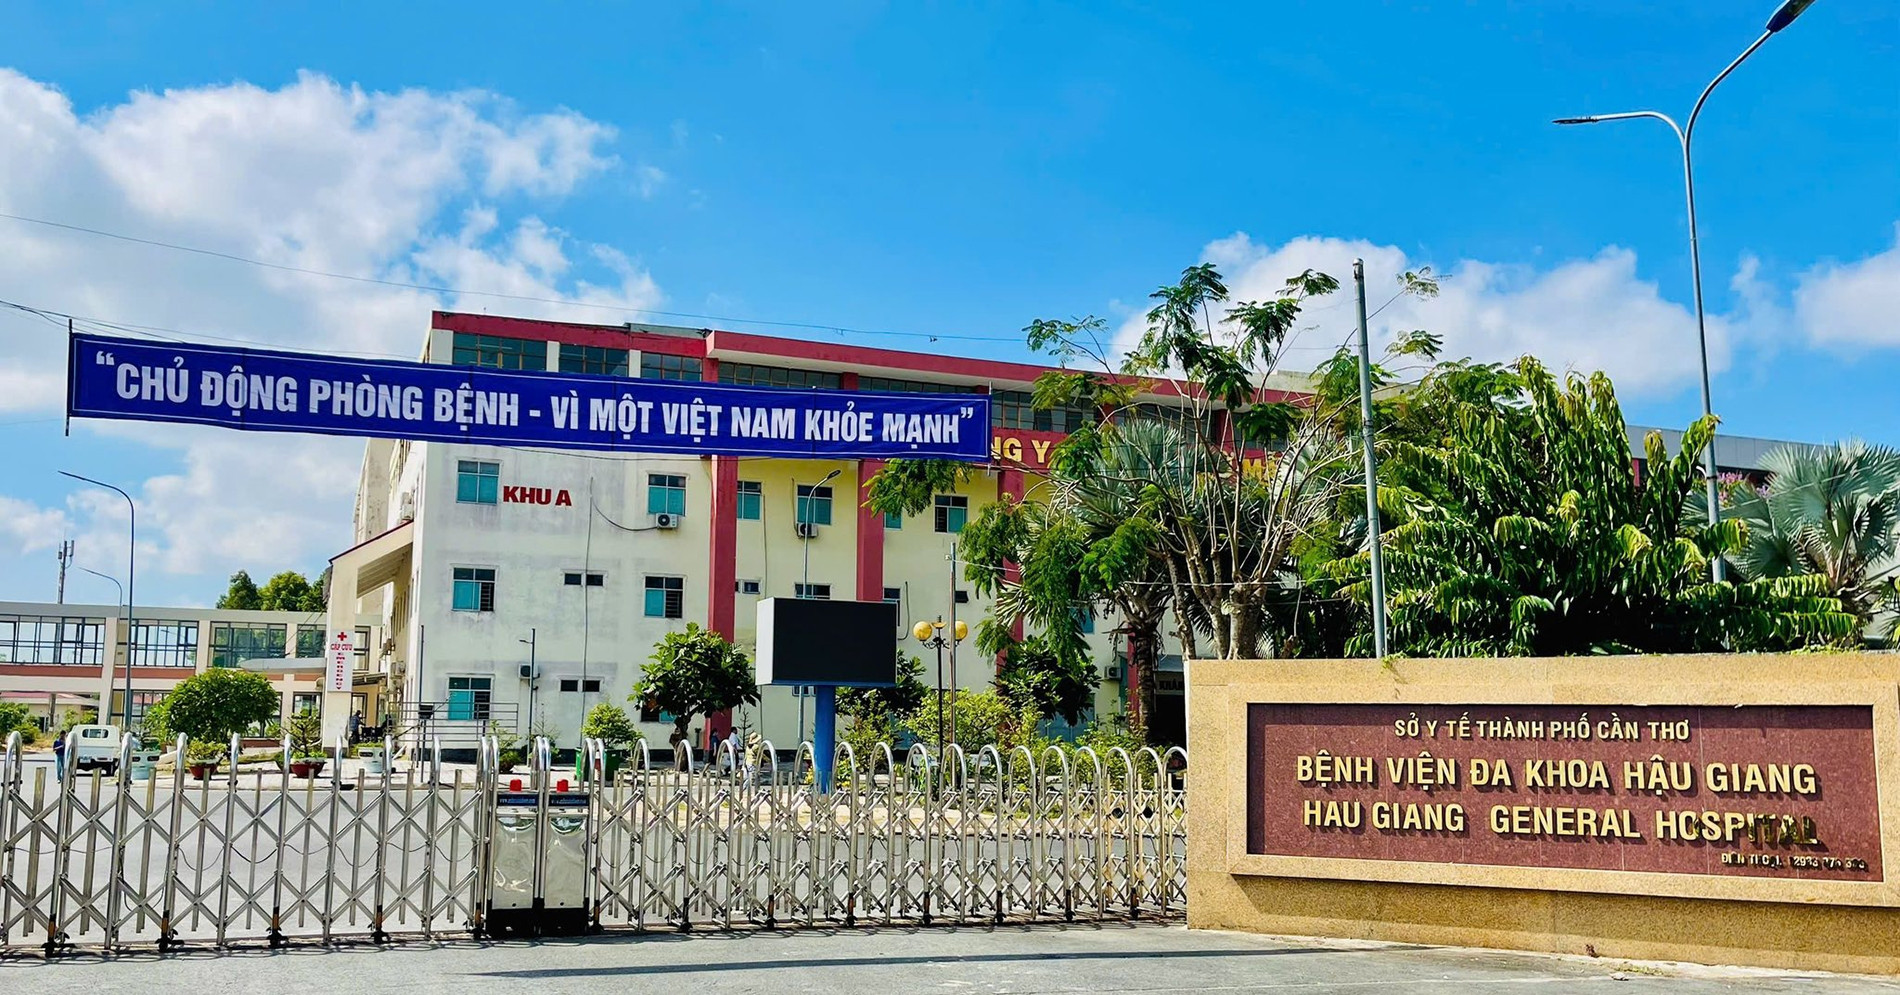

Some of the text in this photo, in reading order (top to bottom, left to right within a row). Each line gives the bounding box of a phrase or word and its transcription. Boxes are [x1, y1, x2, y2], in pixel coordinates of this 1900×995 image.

[200, 365, 298, 417] ĐỘNG
[309, 374, 423, 421] PHÒNG
[434, 382, 519, 431] BỆNH
[550, 390, 580, 431] VÌ
[589, 393, 653, 440] MỘT
[662, 397, 723, 442] VIỆT
[731, 407, 796, 441] NAM
[805, 400, 873, 442] KHỎE
[1031, 439, 1051, 463] Y
[503, 486, 572, 506] KHU A
[1394, 712, 1690, 740] SỞ Y TẾ THÀNH PHỐ CẦN THƠ
[1297, 749, 1817, 795] BỆNH VIỆN ĐA KHOA HẬU GIANG
[1303, 800, 1821, 845] HAU GIANG GENERAL HOSPITAL
